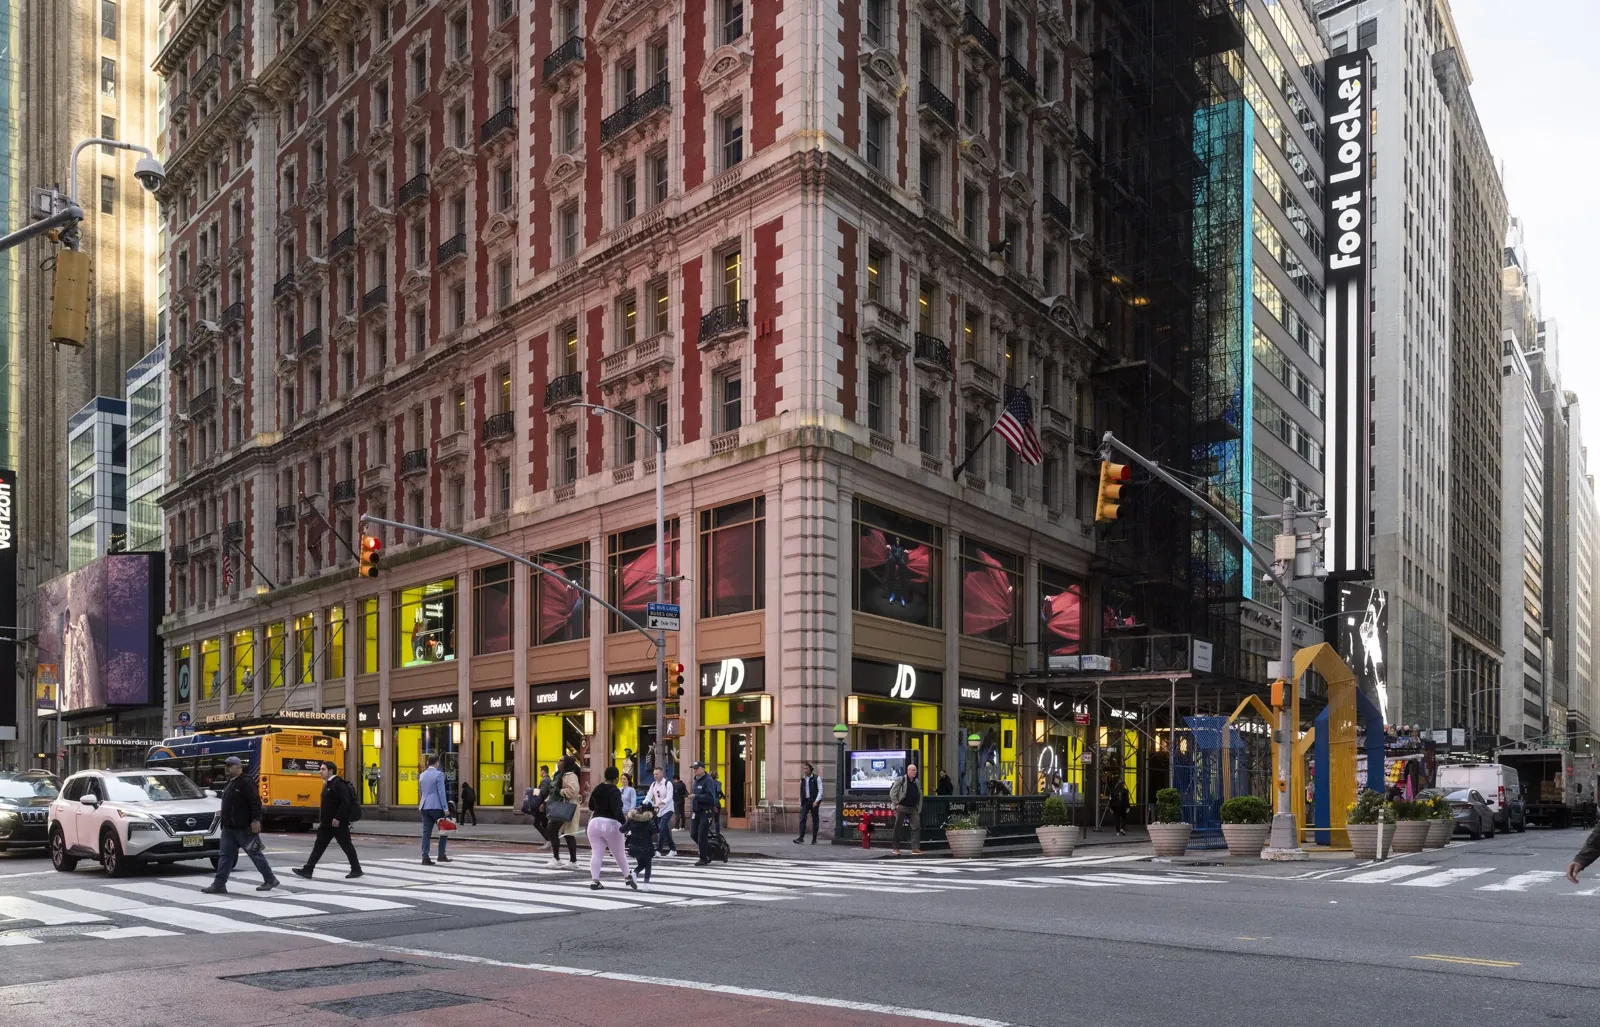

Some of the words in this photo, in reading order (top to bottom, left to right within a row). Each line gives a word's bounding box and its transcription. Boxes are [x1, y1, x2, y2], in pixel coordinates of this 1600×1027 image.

[1330, 65, 1361, 184] Locker
[1330, 190, 1361, 269] Foot
[0, 484, 11, 549] verizon
[711, 658, 745, 697] JD
[890, 663, 916, 699] JD
[537, 690, 558, 704] unreal
[961, 687, 981, 700] unreal
[490, 696, 502, 708] feel
[279, 709, 347, 721] KNICKERBOCKER
[358, 711, 367, 722] the
[97, 738, 122, 746] Hilton
[122, 739, 148, 747] Garden
